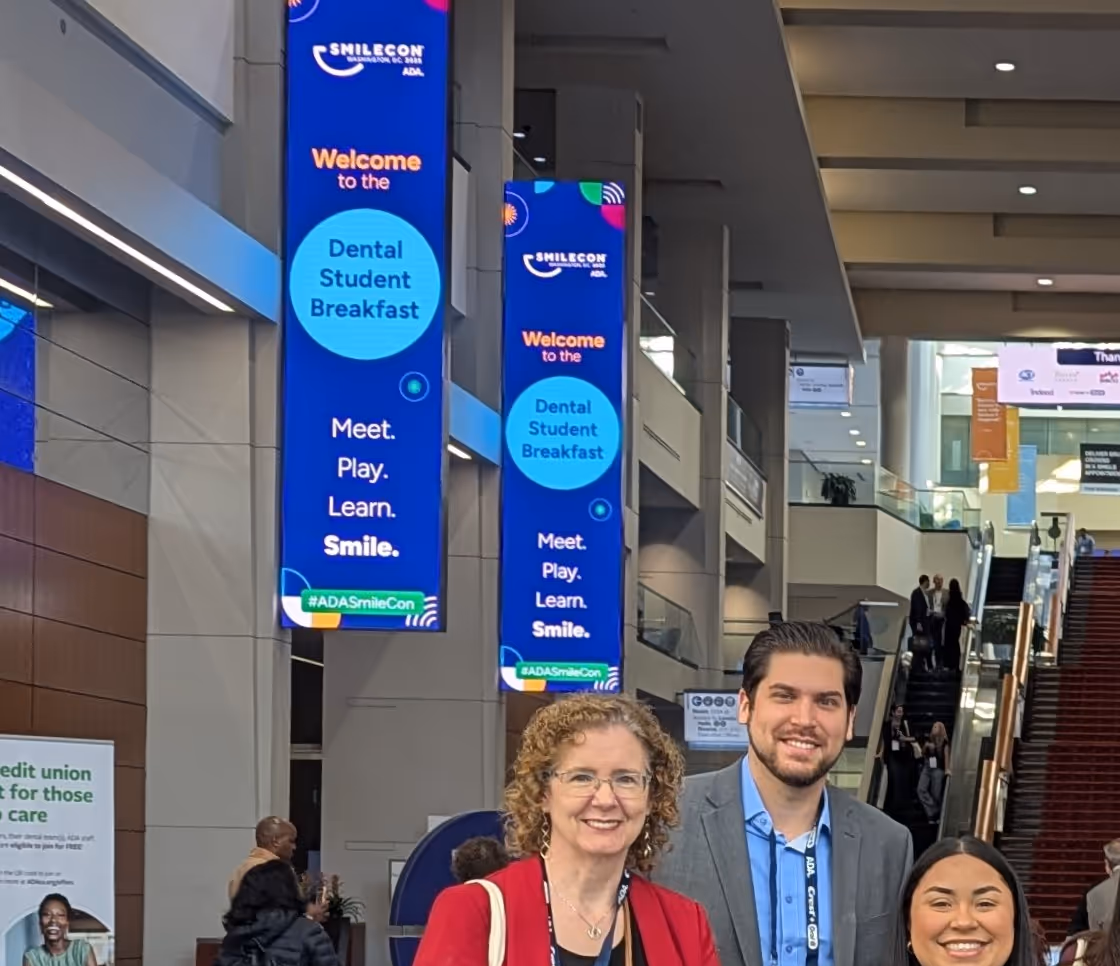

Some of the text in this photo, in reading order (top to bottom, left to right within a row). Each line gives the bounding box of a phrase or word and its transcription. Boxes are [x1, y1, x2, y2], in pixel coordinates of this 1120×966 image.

[330, 43, 423, 57] SMILECON
[312, 148, 421, 171] Welcome
[338, 174, 389, 189] to the
[330, 239, 402, 258] Dental
[536, 252, 607, 263] SMILECON
[320, 268, 410, 289] Student
[311, 298, 419, 319] Breakfast
[522, 331, 605, 348] Welcome
[542, 350, 582, 363] to the
[536, 399, 591, 414] Dental
[332, 418, 395, 439] Meet.
[529, 421, 597, 436] Student
[522, 444, 603, 459] Breakfast
[338, 457, 388, 483] Play.
[329, 496, 395, 517] Learn.
[324, 535, 399, 557] Smile.
[538, 533, 586, 549] Meet.
[543, 562, 581, 583] Play.
[308, 596, 415, 610] #ADASmileCon
[536, 592, 587, 608] Learn.
[532, 621, 590, 638] Smile.
[521, 666, 601, 678] #ADASmileCon
[42, 764, 91, 781] union
[10, 783, 38, 800] for
[43, 786, 93, 802] those
[8, 810, 47, 822] care
[806, 856, 816, 878] ADA
[808, 885, 816, 917] Crest
